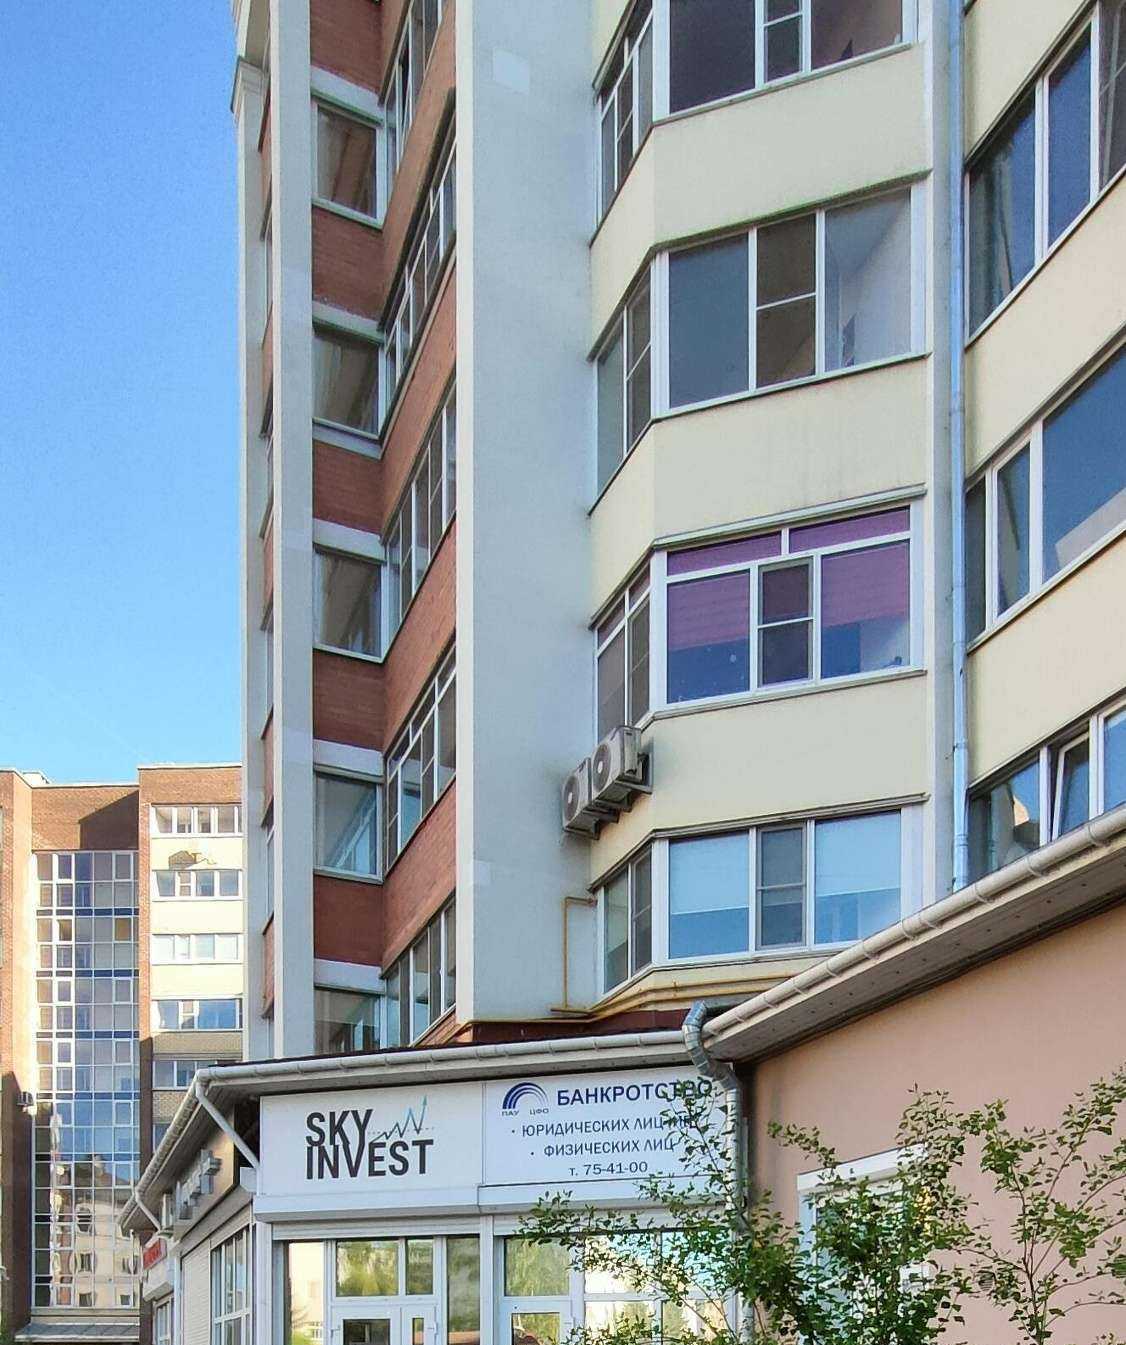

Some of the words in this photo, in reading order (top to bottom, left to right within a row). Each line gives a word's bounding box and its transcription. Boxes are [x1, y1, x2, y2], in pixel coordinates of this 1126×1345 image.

[557, 1080, 713, 1107] БАНКРОТСТВО
[529, 1108, 550, 1116] ЦФО
[306, 1109, 373, 1147] SKY
[522, 1118, 630, 1138] ЮРИДИЧЕСКИХ
[633, 1117, 664, 1131] ЛИЦ
[544, 1140, 640, 1158] ФИЗИЧЕСКИХ
[643, 1138, 674, 1153] ЛИЦ
[306, 1139, 434, 1180] INVEST
[583, 1161, 648, 1176] 75-41-00
